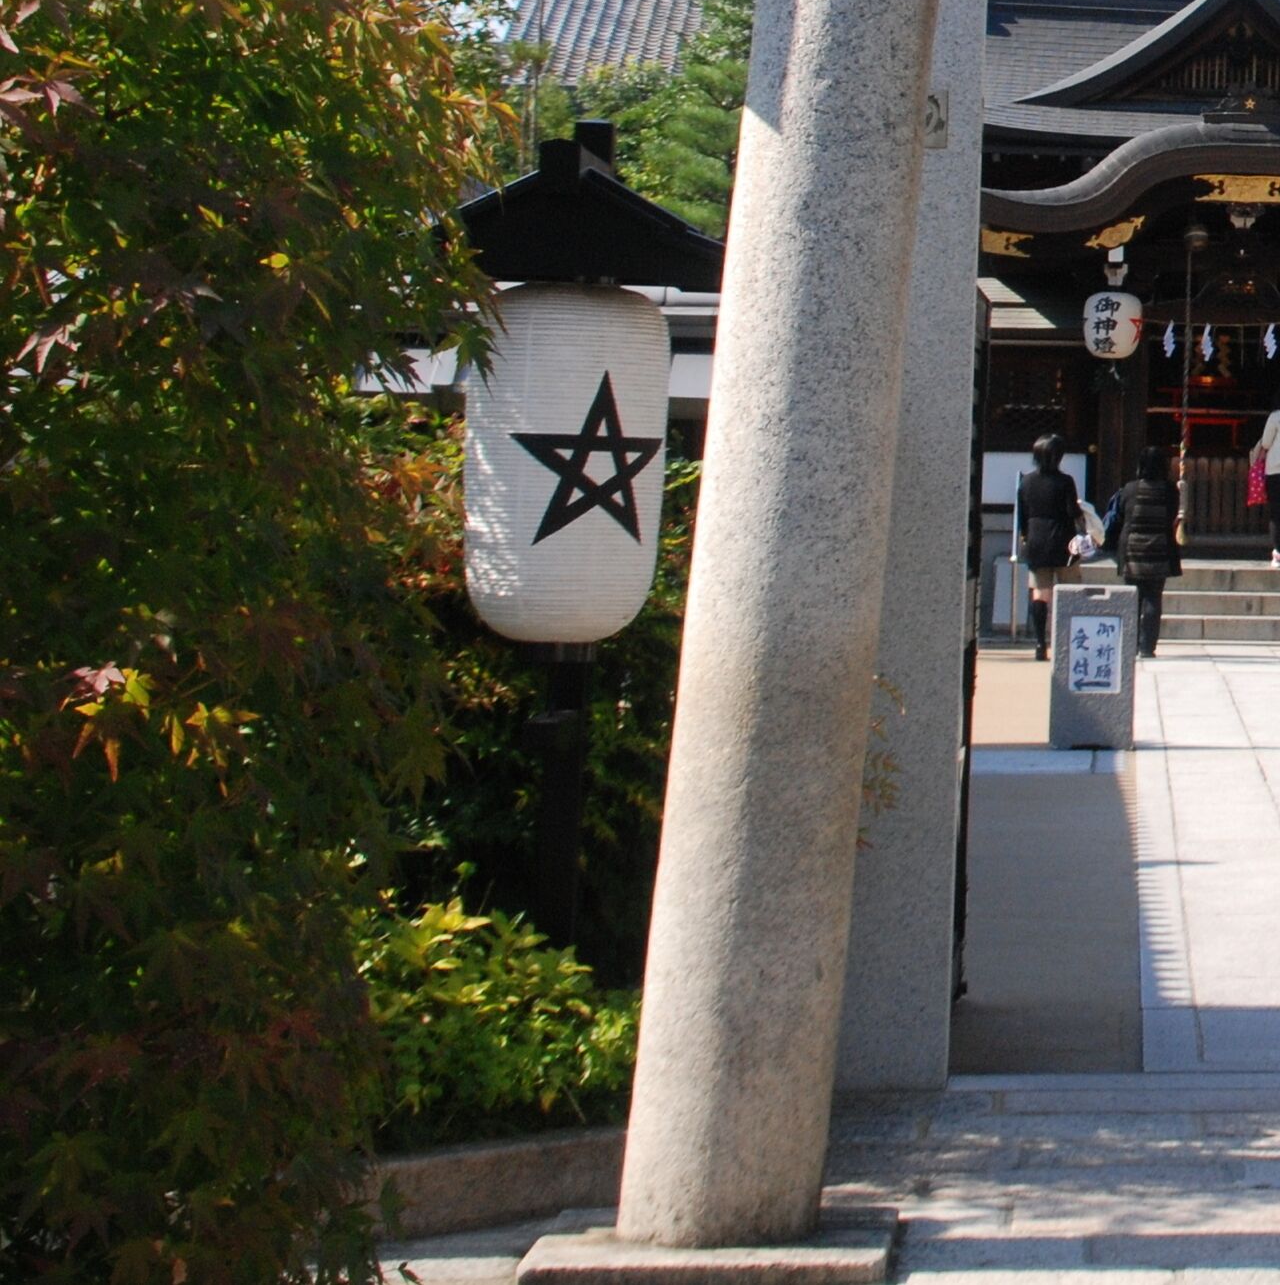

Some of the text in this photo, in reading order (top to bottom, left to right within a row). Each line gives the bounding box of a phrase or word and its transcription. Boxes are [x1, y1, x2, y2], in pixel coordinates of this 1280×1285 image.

[1093, 295, 1121, 354] 御神燈
[1072, 627, 1090, 677] 受付
[1096, 622, 1115, 679] 御祈願
